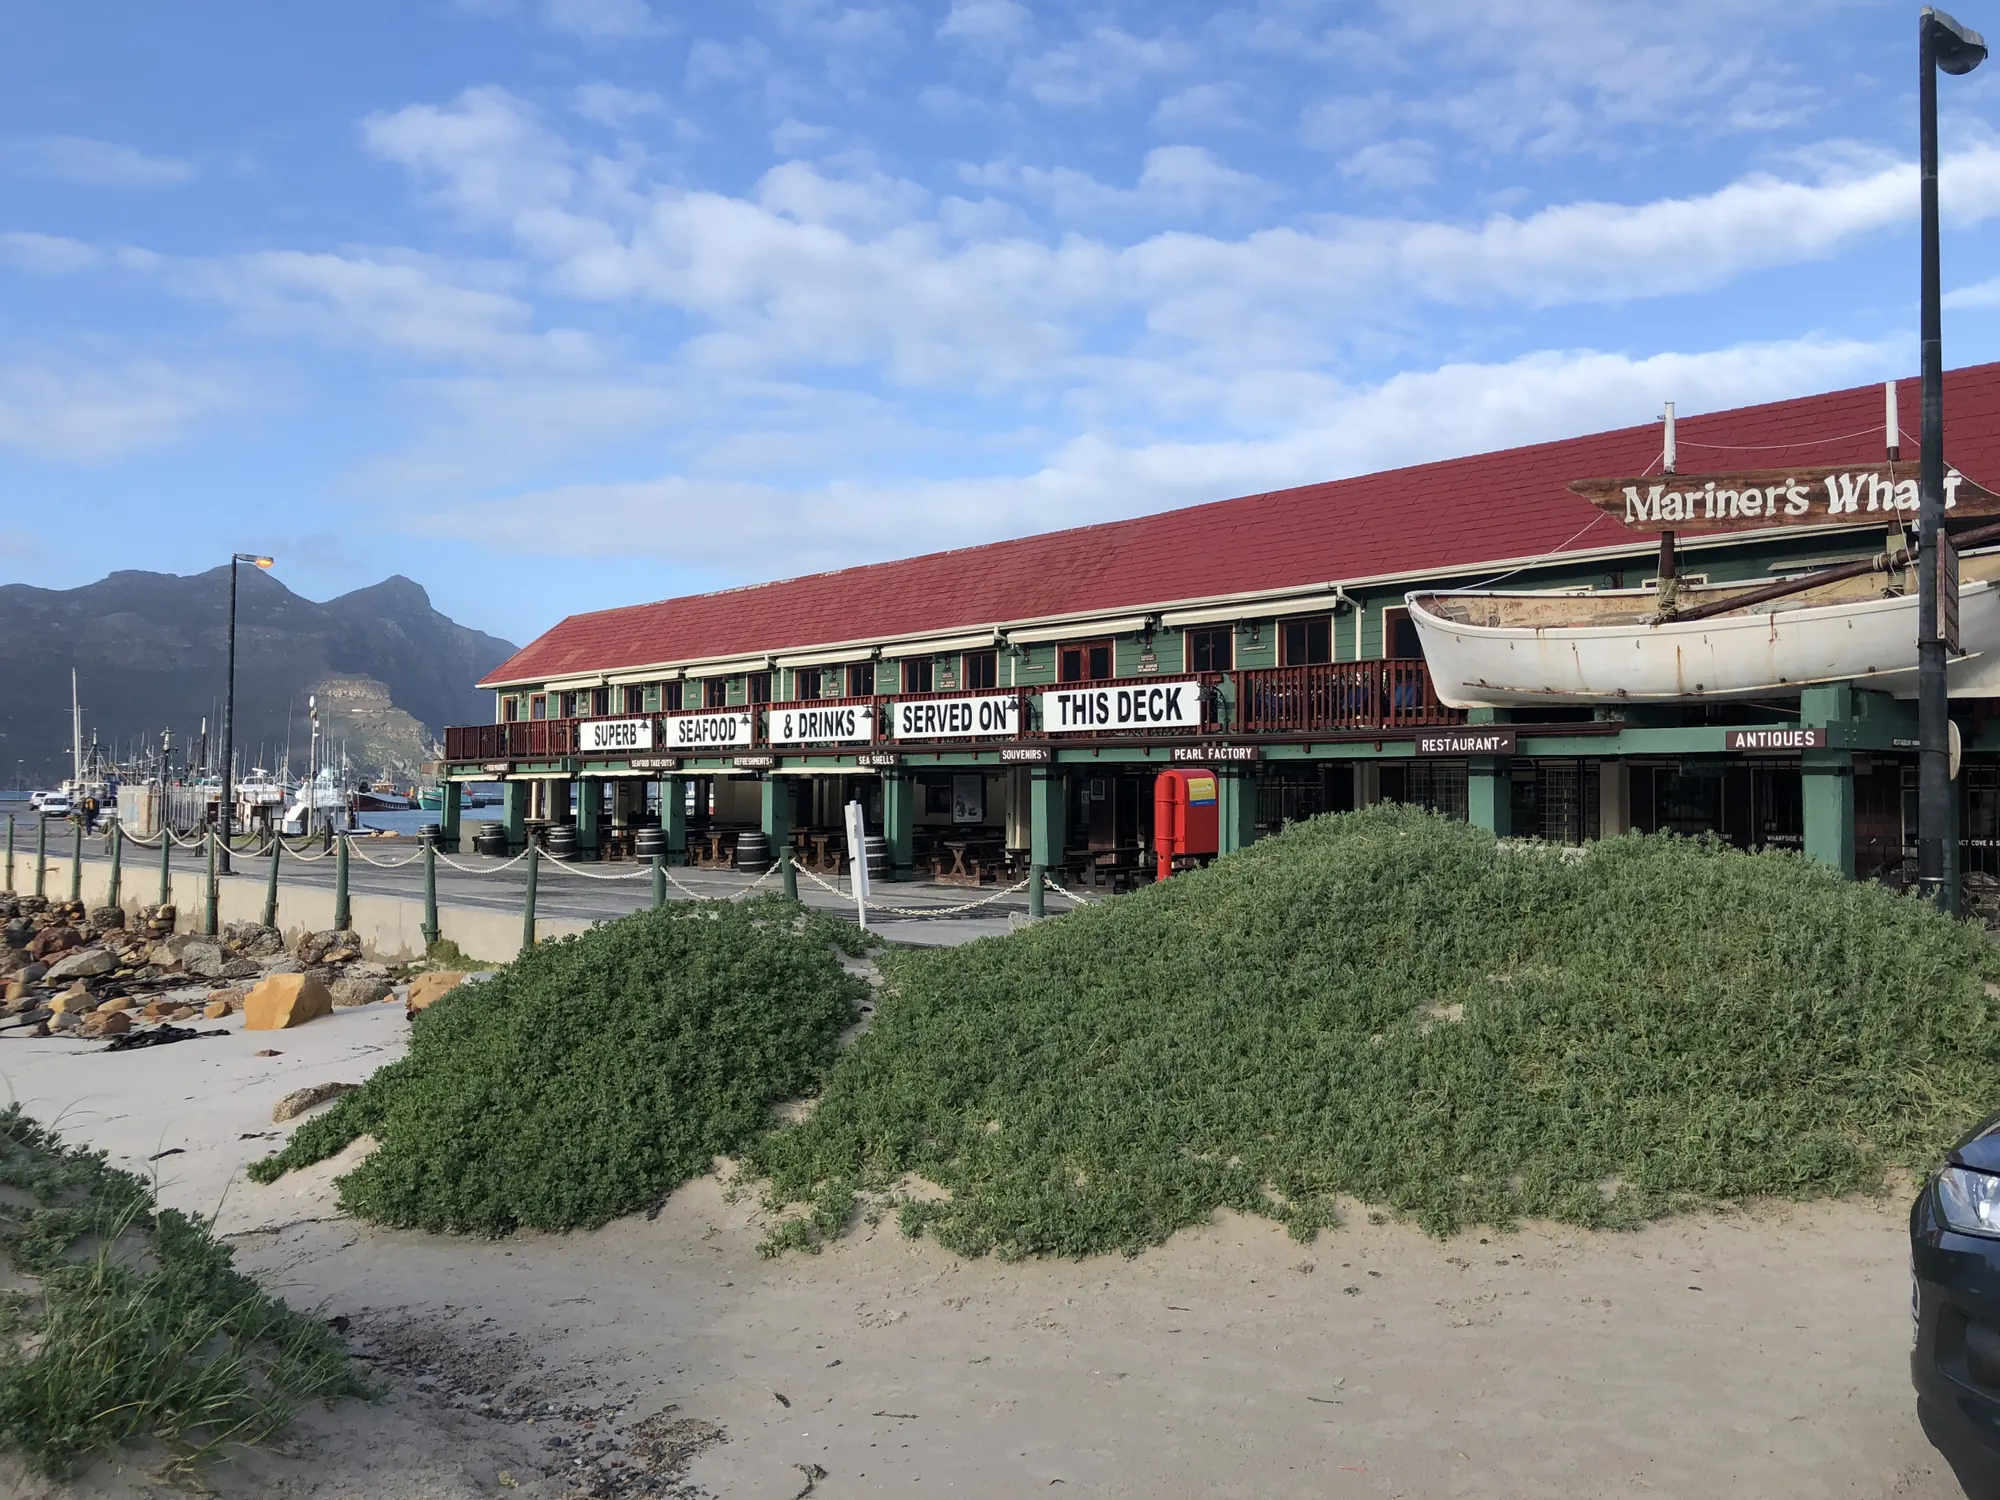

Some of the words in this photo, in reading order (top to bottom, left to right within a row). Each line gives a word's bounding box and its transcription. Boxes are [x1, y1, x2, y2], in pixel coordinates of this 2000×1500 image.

[1622, 477, 1810, 523] Mariner's
[1824, 469, 1962, 514] Whaf
[1057, 692, 1110, 726] THIS
[1117, 687, 1183, 723] DECK
[783, 713, 793, 739] &
[798, 709, 856, 738] DRINKS
[902, 703, 973, 734] SERVED
[979, 701, 1008, 731] ON
[594, 723, 637, 747] SUPERB
[678, 717, 737, 743] SEAFOOD
[1735, 730, 1815, 748] ANTIQUES
[1002, 749, 1042, 760] SOUVENIRS
[1174, 748, 1204, 760] PEARL
[1208, 747, 1252, 760] FACTORY
[1422, 737, 1500, 752] RESTAURANT
[733, 756, 770, 766] REFRESHMENTS
[858, 755, 871, 765] SEA
[871, 754, 895, 765] SHELLS
